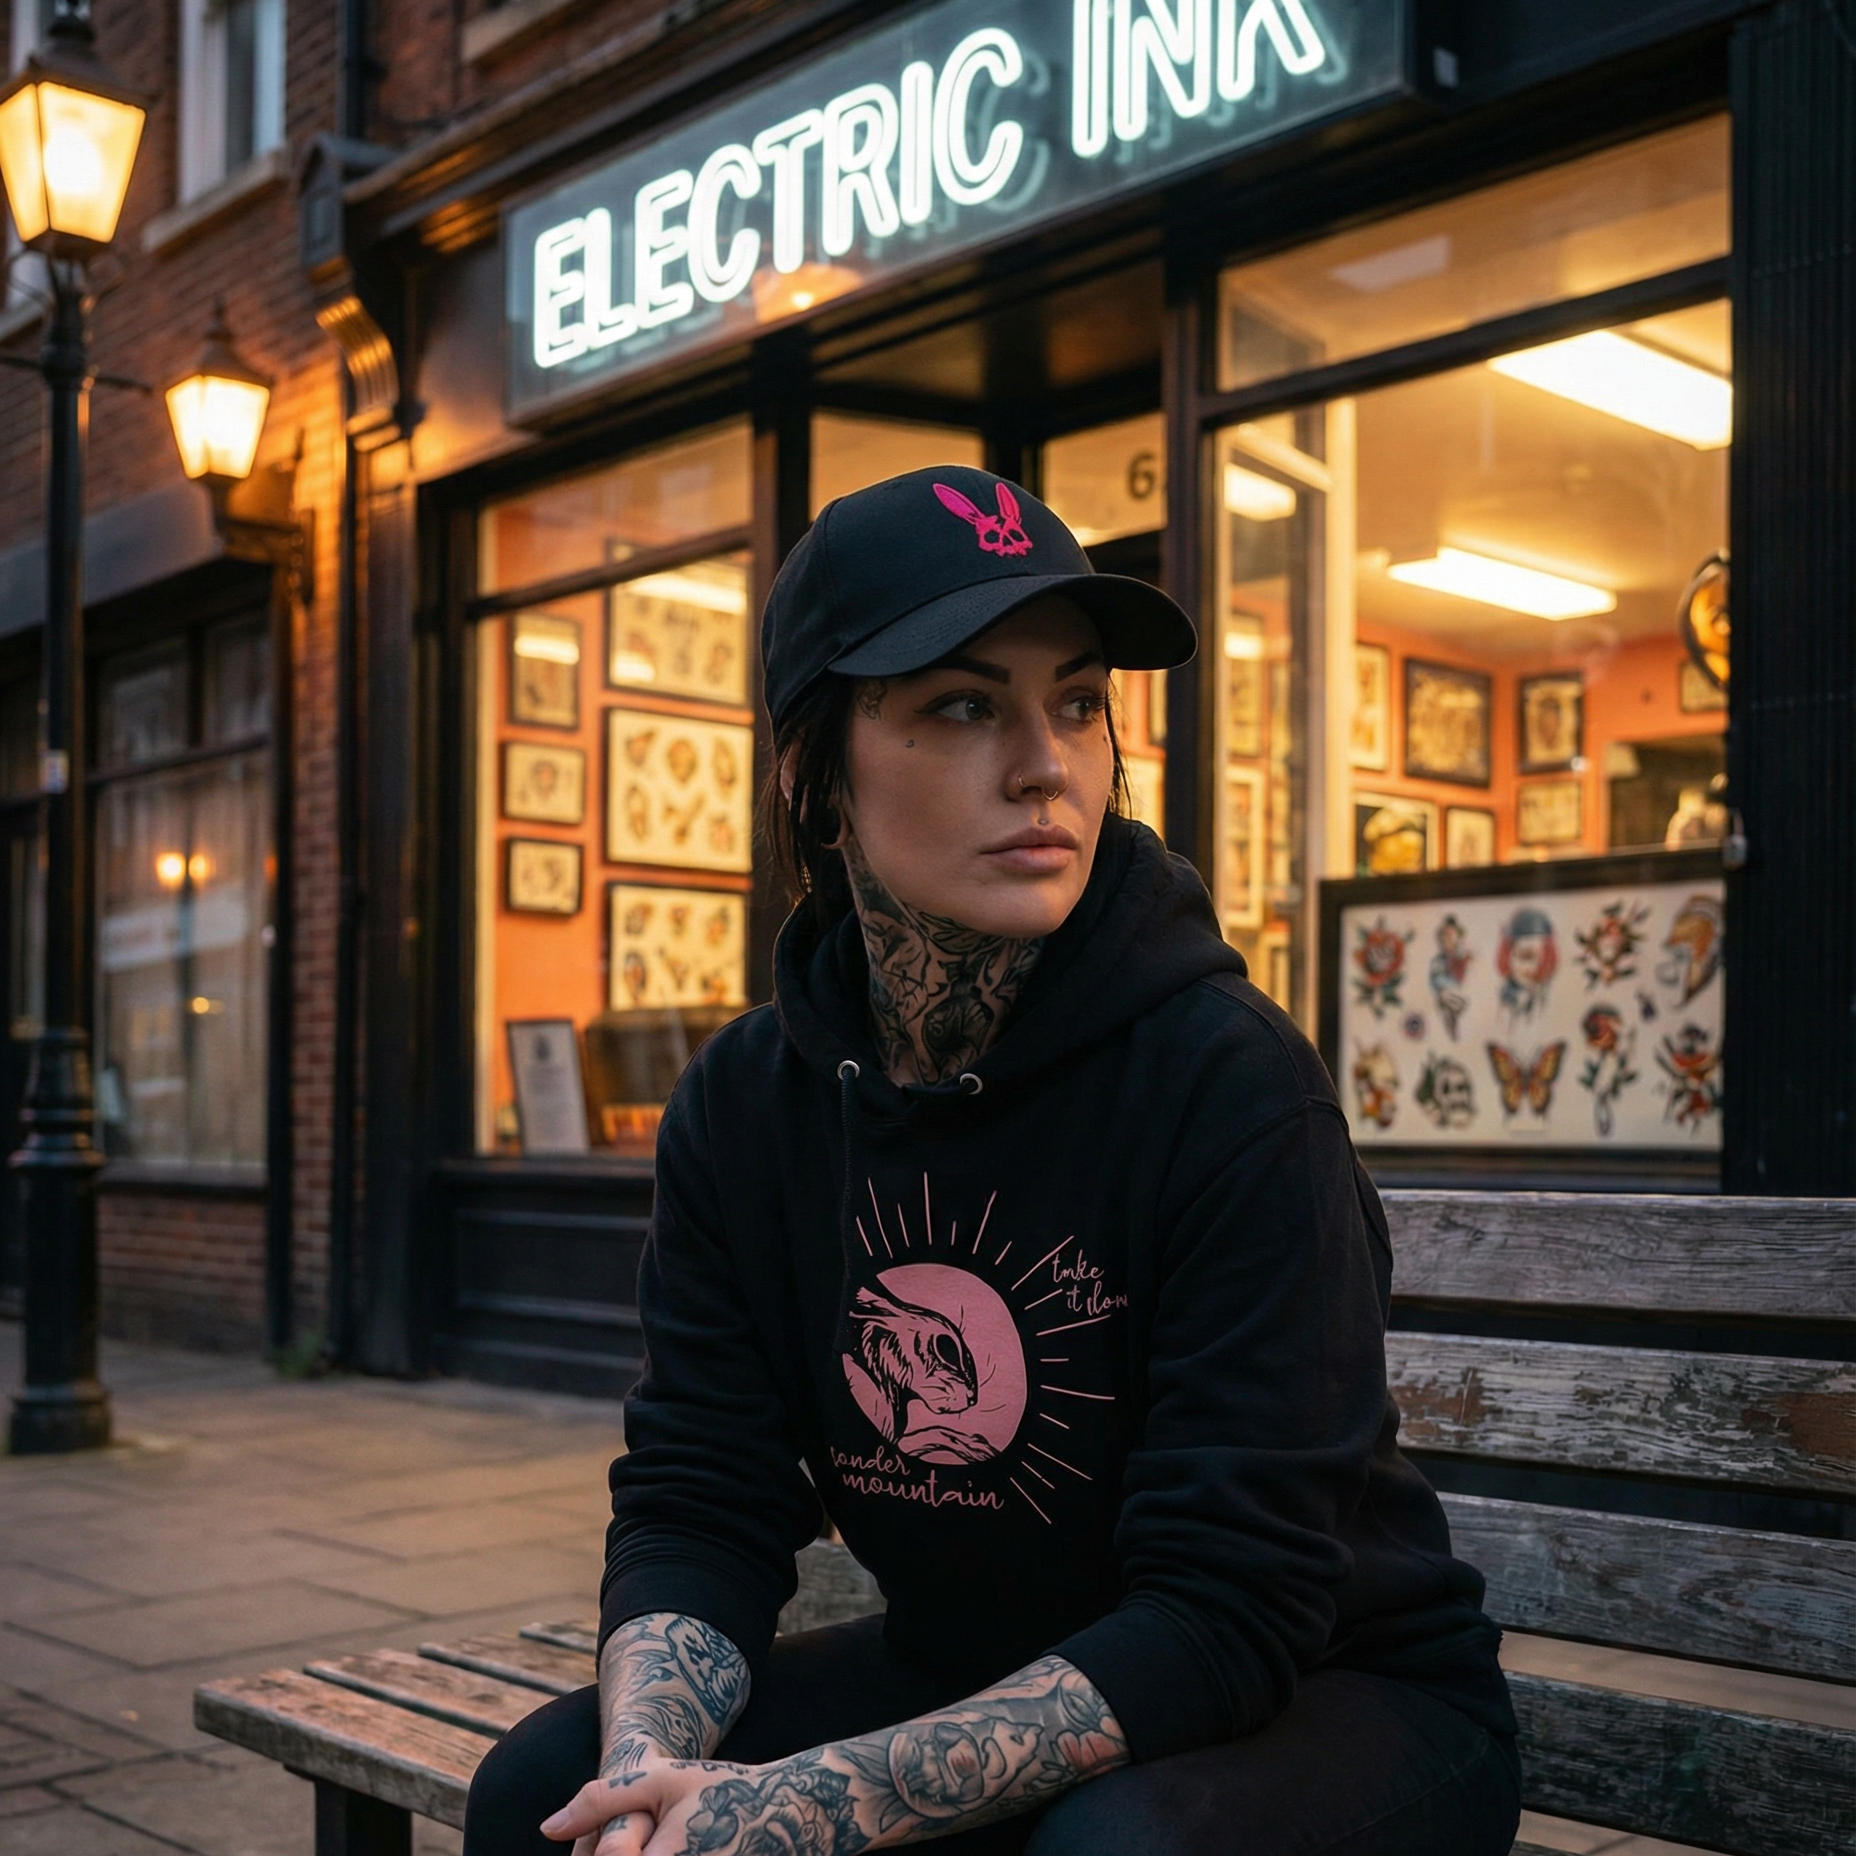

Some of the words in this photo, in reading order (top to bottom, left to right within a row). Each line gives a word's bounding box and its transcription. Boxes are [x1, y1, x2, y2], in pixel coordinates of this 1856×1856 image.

[535, 28, 1024, 368] ELECTRIC
[1126, 452, 1156, 501] 6
[842, 1469, 1005, 1510] mountain
